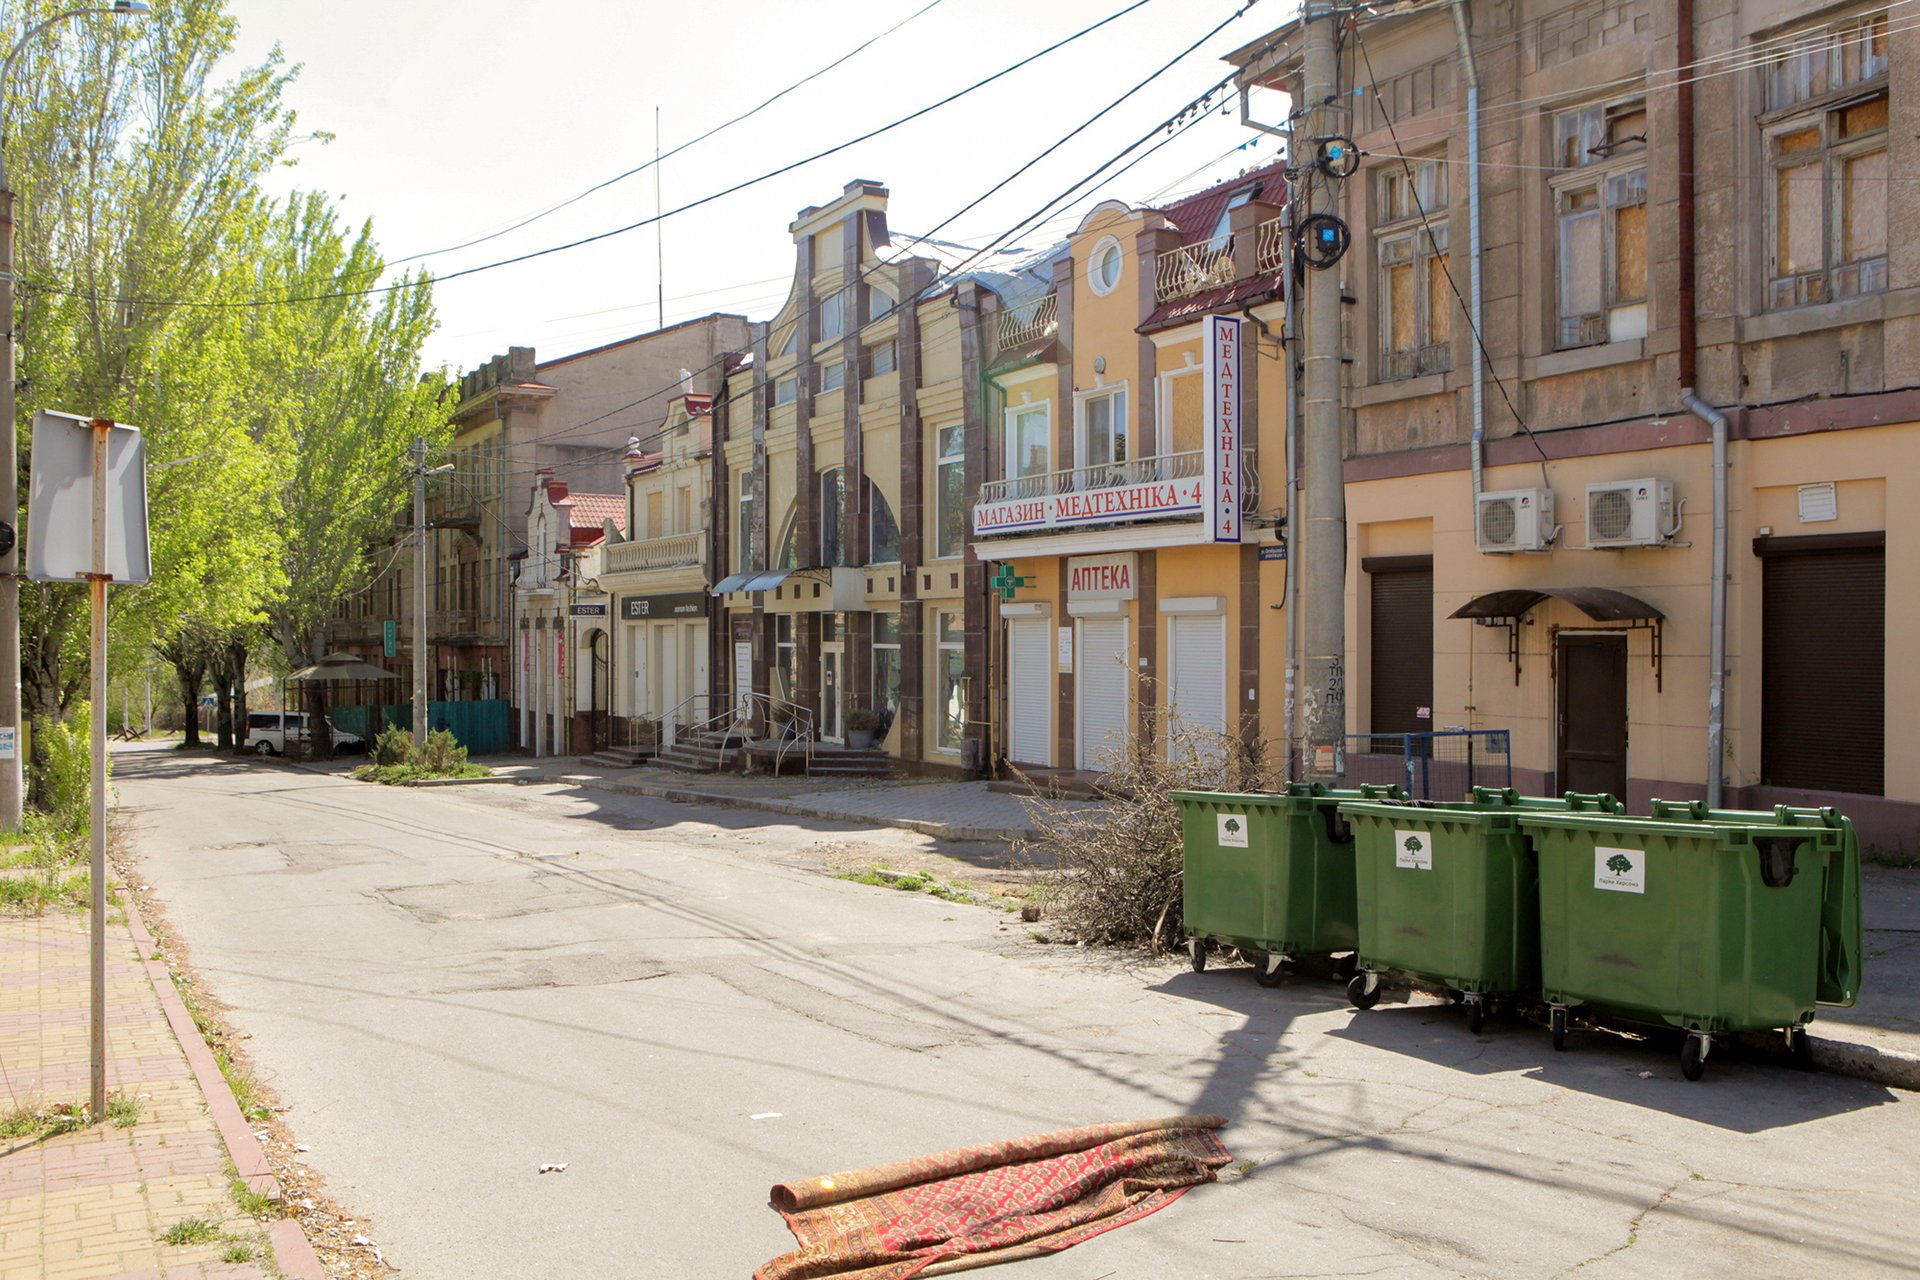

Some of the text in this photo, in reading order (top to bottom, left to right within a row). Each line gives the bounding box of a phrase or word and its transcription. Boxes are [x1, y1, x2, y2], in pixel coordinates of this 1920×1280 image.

[1219, 326, 1234, 534] МЕДТЕХНІКА 4
[977, 482, 1202, 527] МАГАЗИН МЕДТЕХНІКА 4
[1071, 564, 1131, 591] АПТЕКА
[577, 606, 600, 615] ESTER
[630, 600, 650, 616] ESTER
